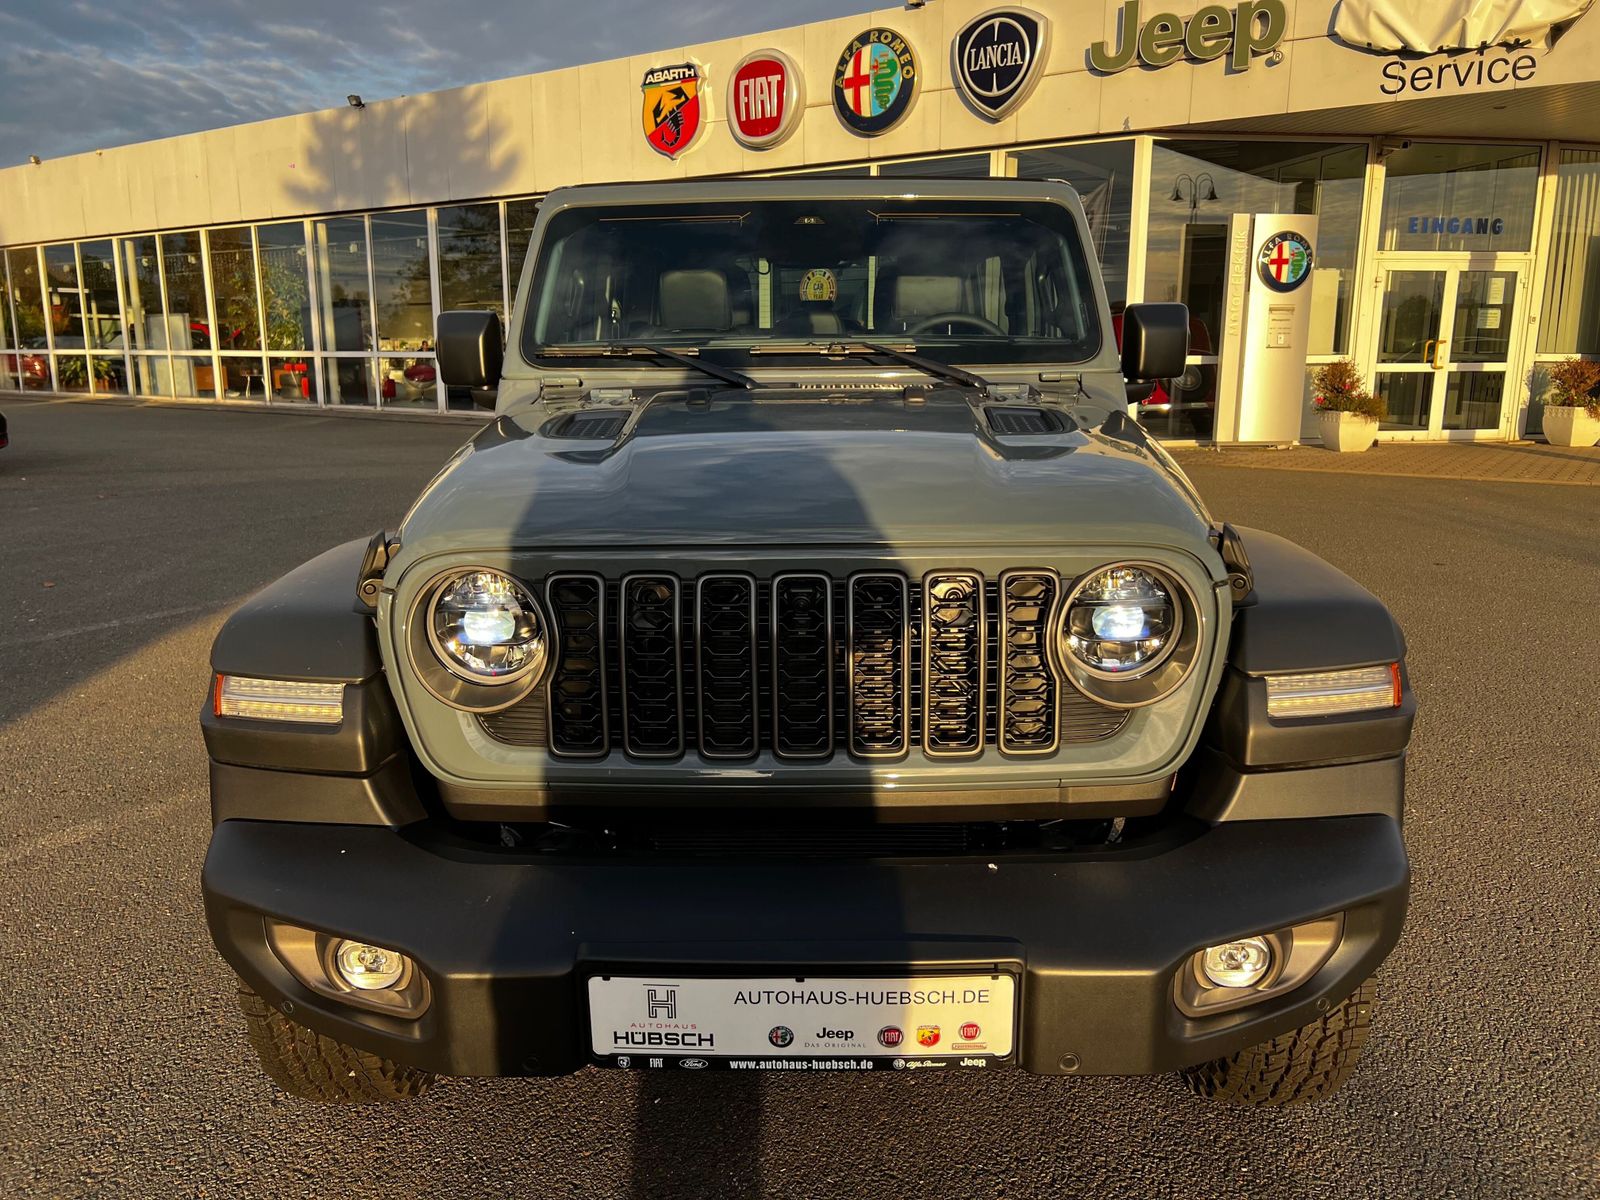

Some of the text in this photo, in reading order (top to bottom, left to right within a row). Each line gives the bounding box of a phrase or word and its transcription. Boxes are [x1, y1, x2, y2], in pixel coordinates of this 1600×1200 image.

[1090, 0, 1286, 73] Jeep
[835, 30, 915, 89] ALFA ROMEO
[970, 41, 1024, 71] LANCIA
[645, 67, 695, 85] ABARTH
[1379, 53, 1538, 96] Service
[739, 73, 782, 123] FIAT
[1408, 217, 1504, 235] EINGANG
[1262, 236, 1282, 264] ALFA
[734, 989, 990, 1005] AUTOHAUS-HUEBSCH.DE
[630, 1022, 697, 1030] AUTOHAUS
[816, 1027, 854, 1041] Jeep
[964, 1027, 977, 1037] FIAT
[613, 1031, 715, 1047] HÜBSCH
[884, 1032, 899, 1042] FIAT
[649, 1058, 664, 1068] FIAT
[684, 1060, 703, 1068] Ford
[730, 1059, 873, 1070] www.autohaus-huebsch.de
[960, 1058, 987, 1068] Jeep
